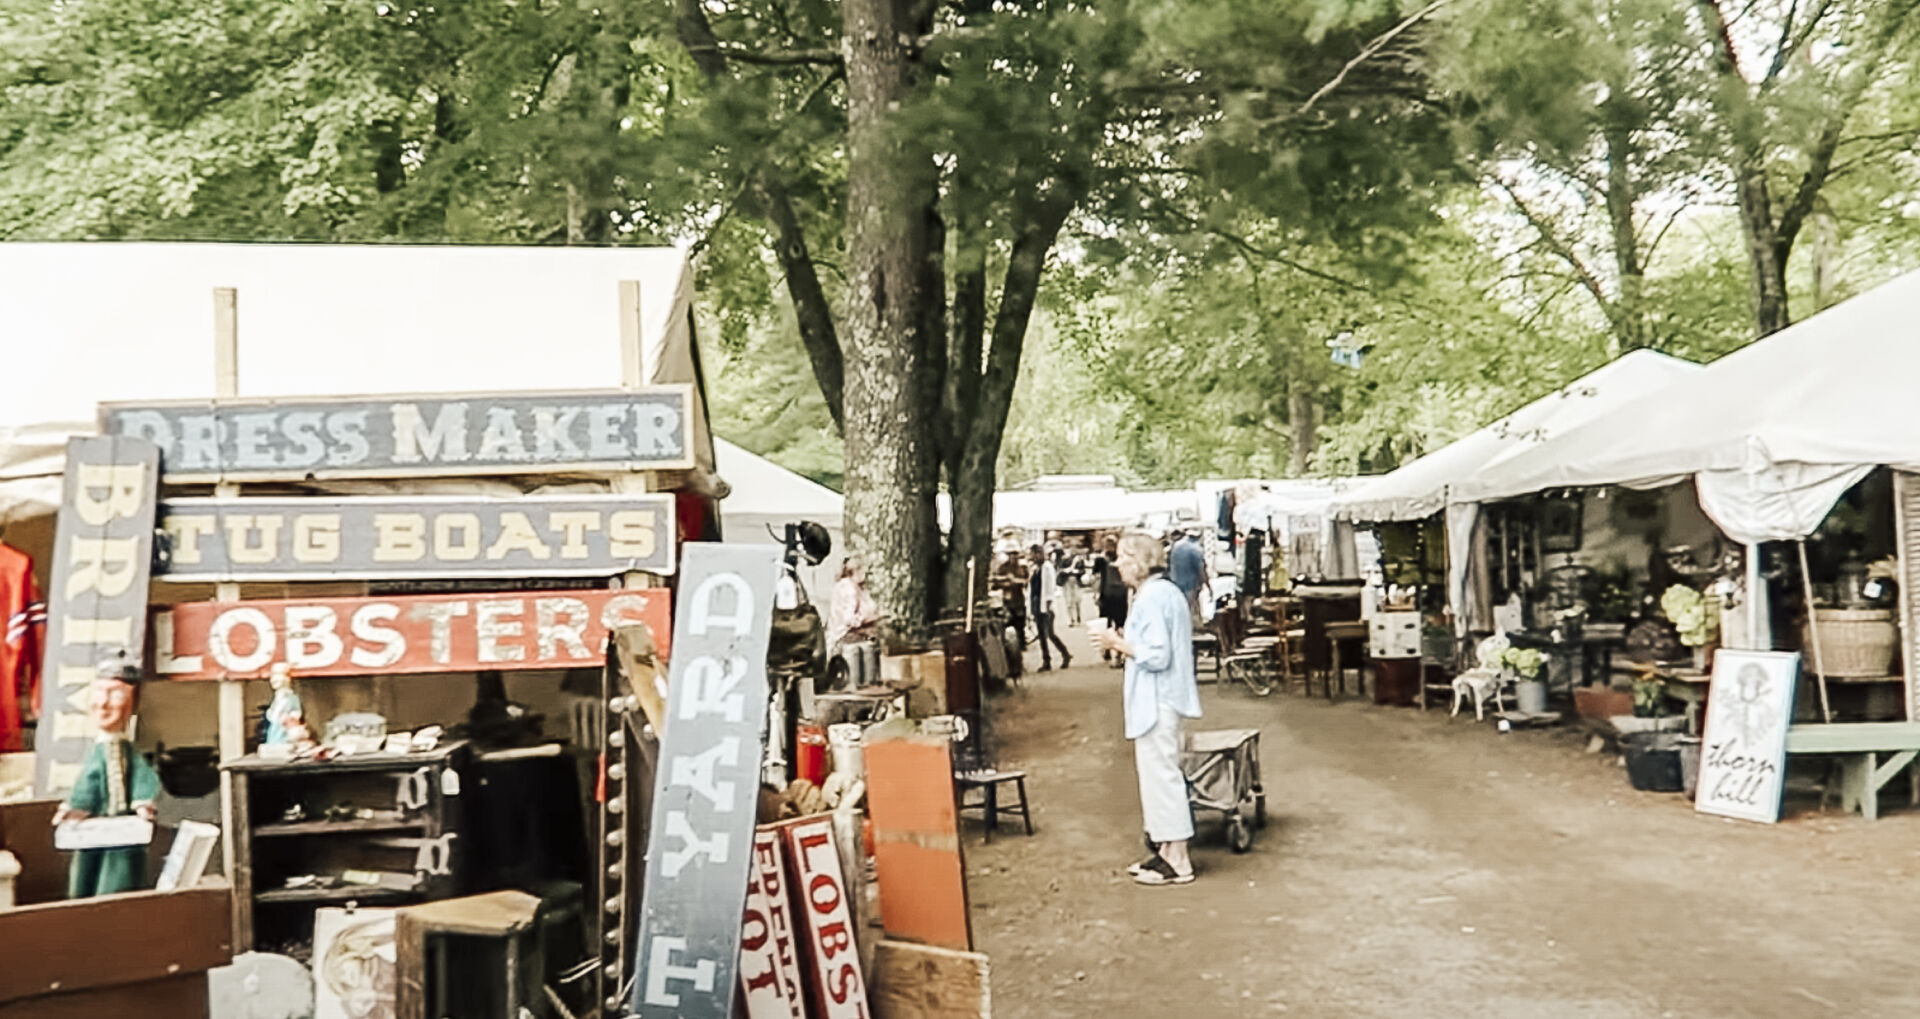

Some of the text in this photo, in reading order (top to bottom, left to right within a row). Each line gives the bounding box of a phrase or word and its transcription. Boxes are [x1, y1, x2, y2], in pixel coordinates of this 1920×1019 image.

[117, 402, 682, 468] DRESS MAKER
[163, 510, 655, 564] TUG BOATS
[660, 571, 756, 878] YARD
[1708, 737, 1775, 774] thorn
[1711, 772, 1763, 806] hill
